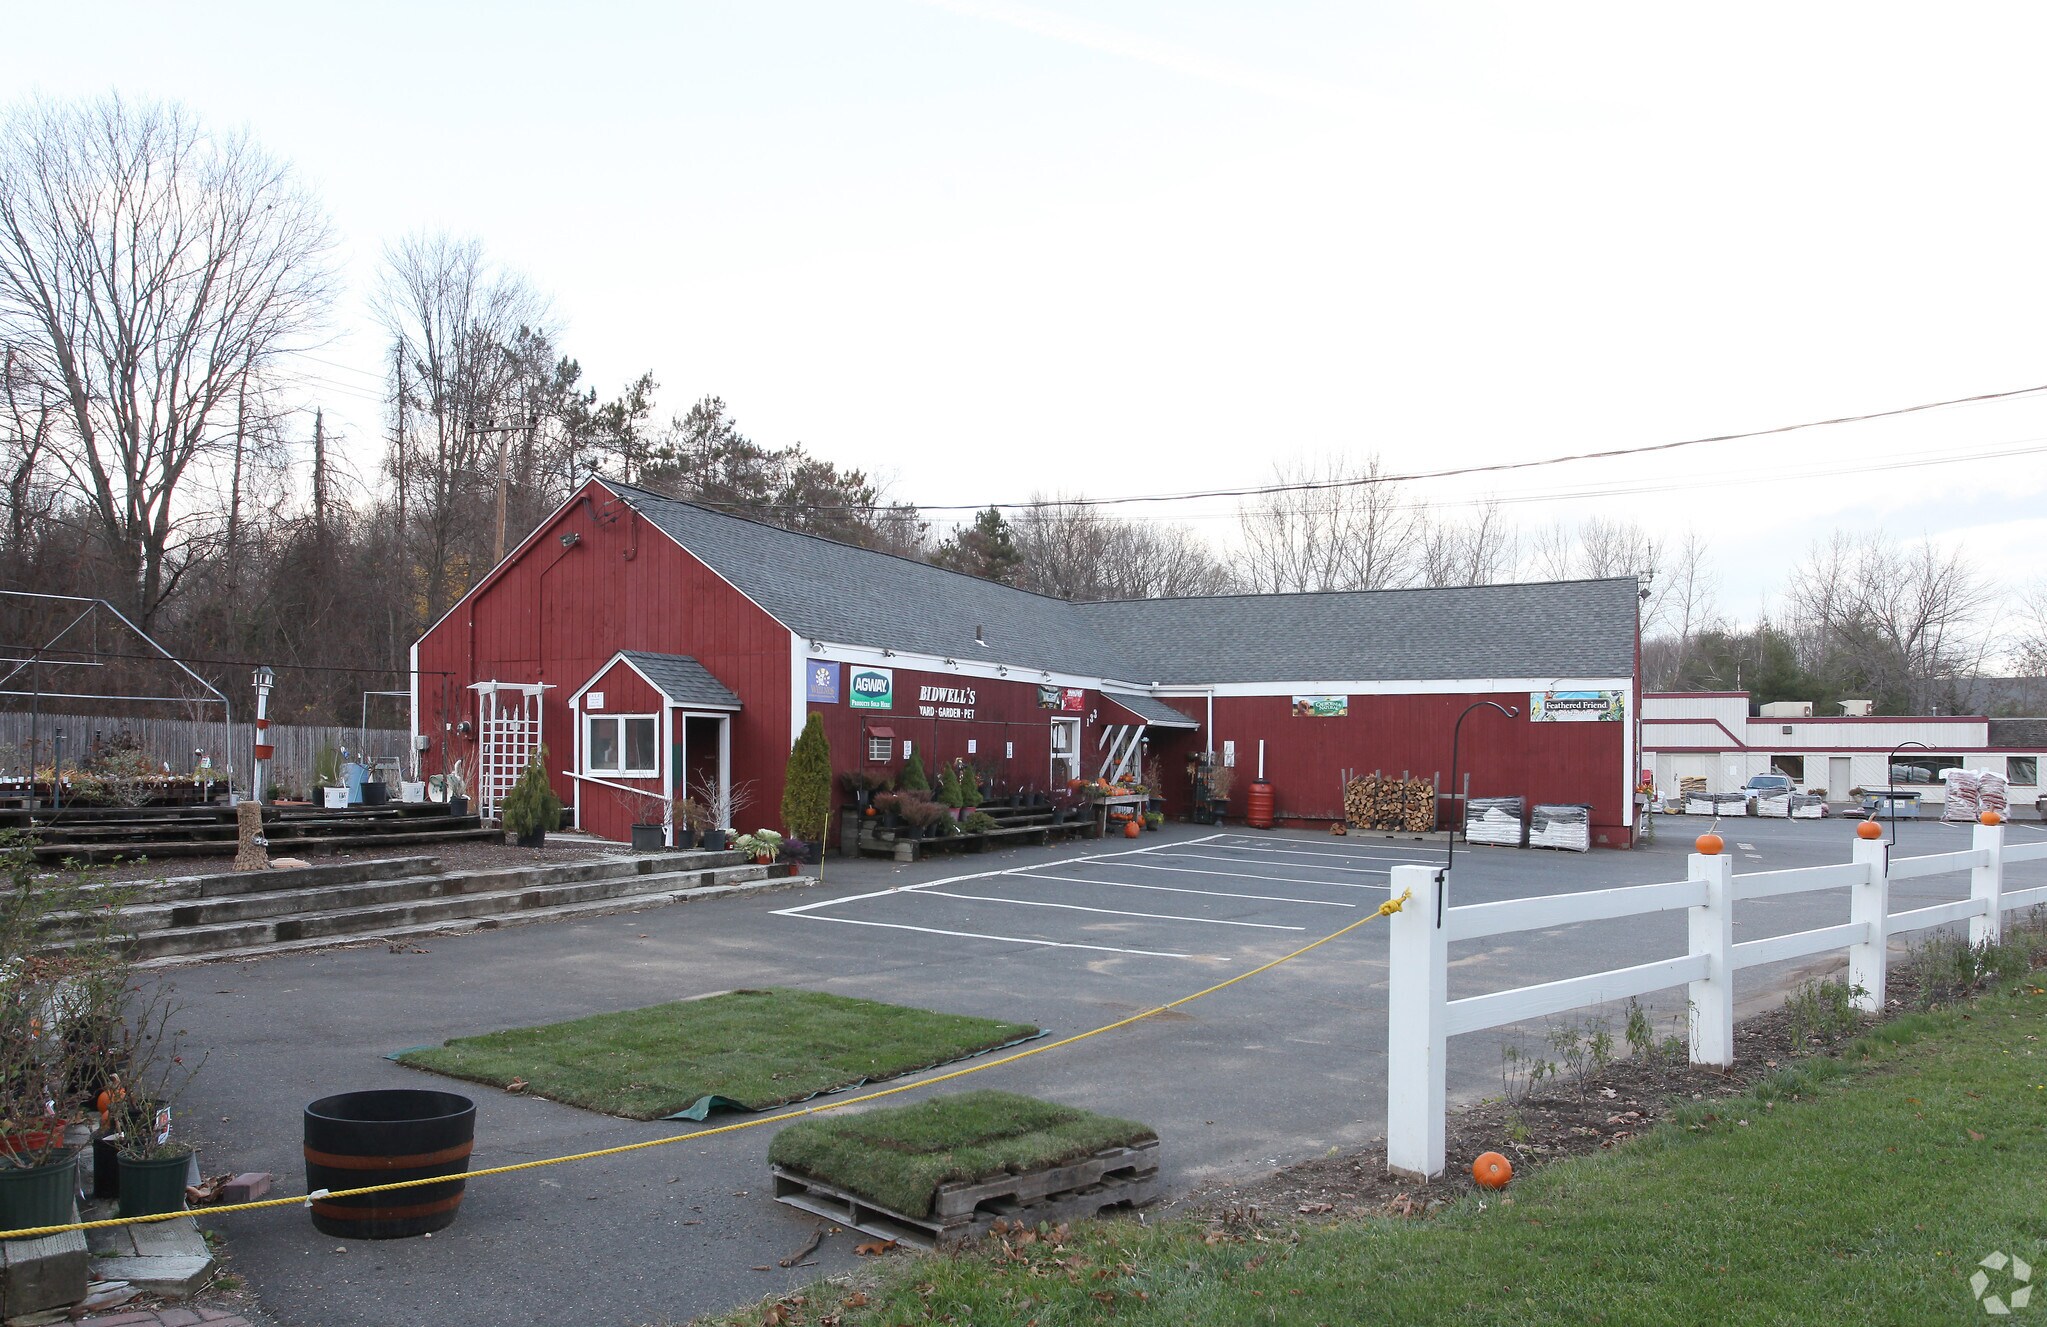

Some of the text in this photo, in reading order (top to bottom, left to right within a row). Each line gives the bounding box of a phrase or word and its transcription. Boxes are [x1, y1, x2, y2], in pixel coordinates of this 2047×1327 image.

[855, 677, 887, 693] AGWAY
[919, 686, 976, 705] BIDWELL'S
[919, 706, 975, 719] YARD GARDEN PET
[1582, 701, 1607, 709] Friend
[1086, 708, 1098, 727] 133
